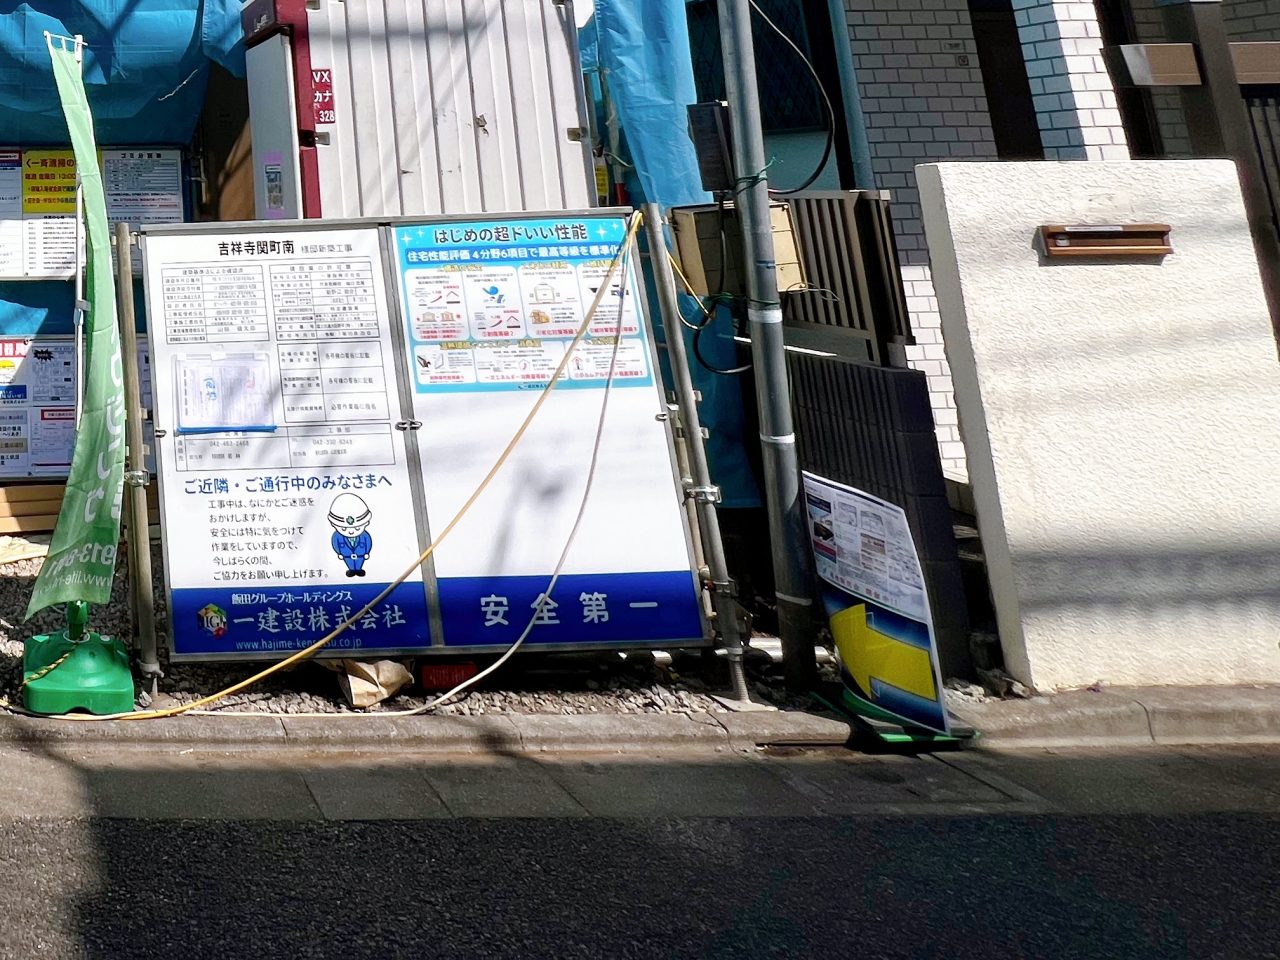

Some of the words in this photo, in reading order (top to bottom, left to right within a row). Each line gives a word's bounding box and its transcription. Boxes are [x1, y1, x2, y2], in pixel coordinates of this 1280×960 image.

[312, 71, 331, 83] VX
[314, 90, 332, 102] カナ
[434, 224, 588, 244] はじめの超ドいい性能
[218, 241, 294, 256] 吉祥寺関町南
[184, 474, 392, 494] ご近隣・ご通行中のみなさまへ
[208, 497, 314, 509] 工事中は、なにかとご迷惑を
[209, 513, 271, 523] おかけしますが、
[210, 526, 304, 538] 安全には特に気をつけて
[211, 541, 299, 552] 作業をしていますので、
[213, 555, 273, 566] 今しばらくの間、
[213, 569, 329, 581] ご協力をお願い申し上げます。
[232, 591, 353, 605] 飯田グループホールディングス
[480, 592, 658, 627] 安全第一
[233, 605, 407, 633] 一建設株式会社
